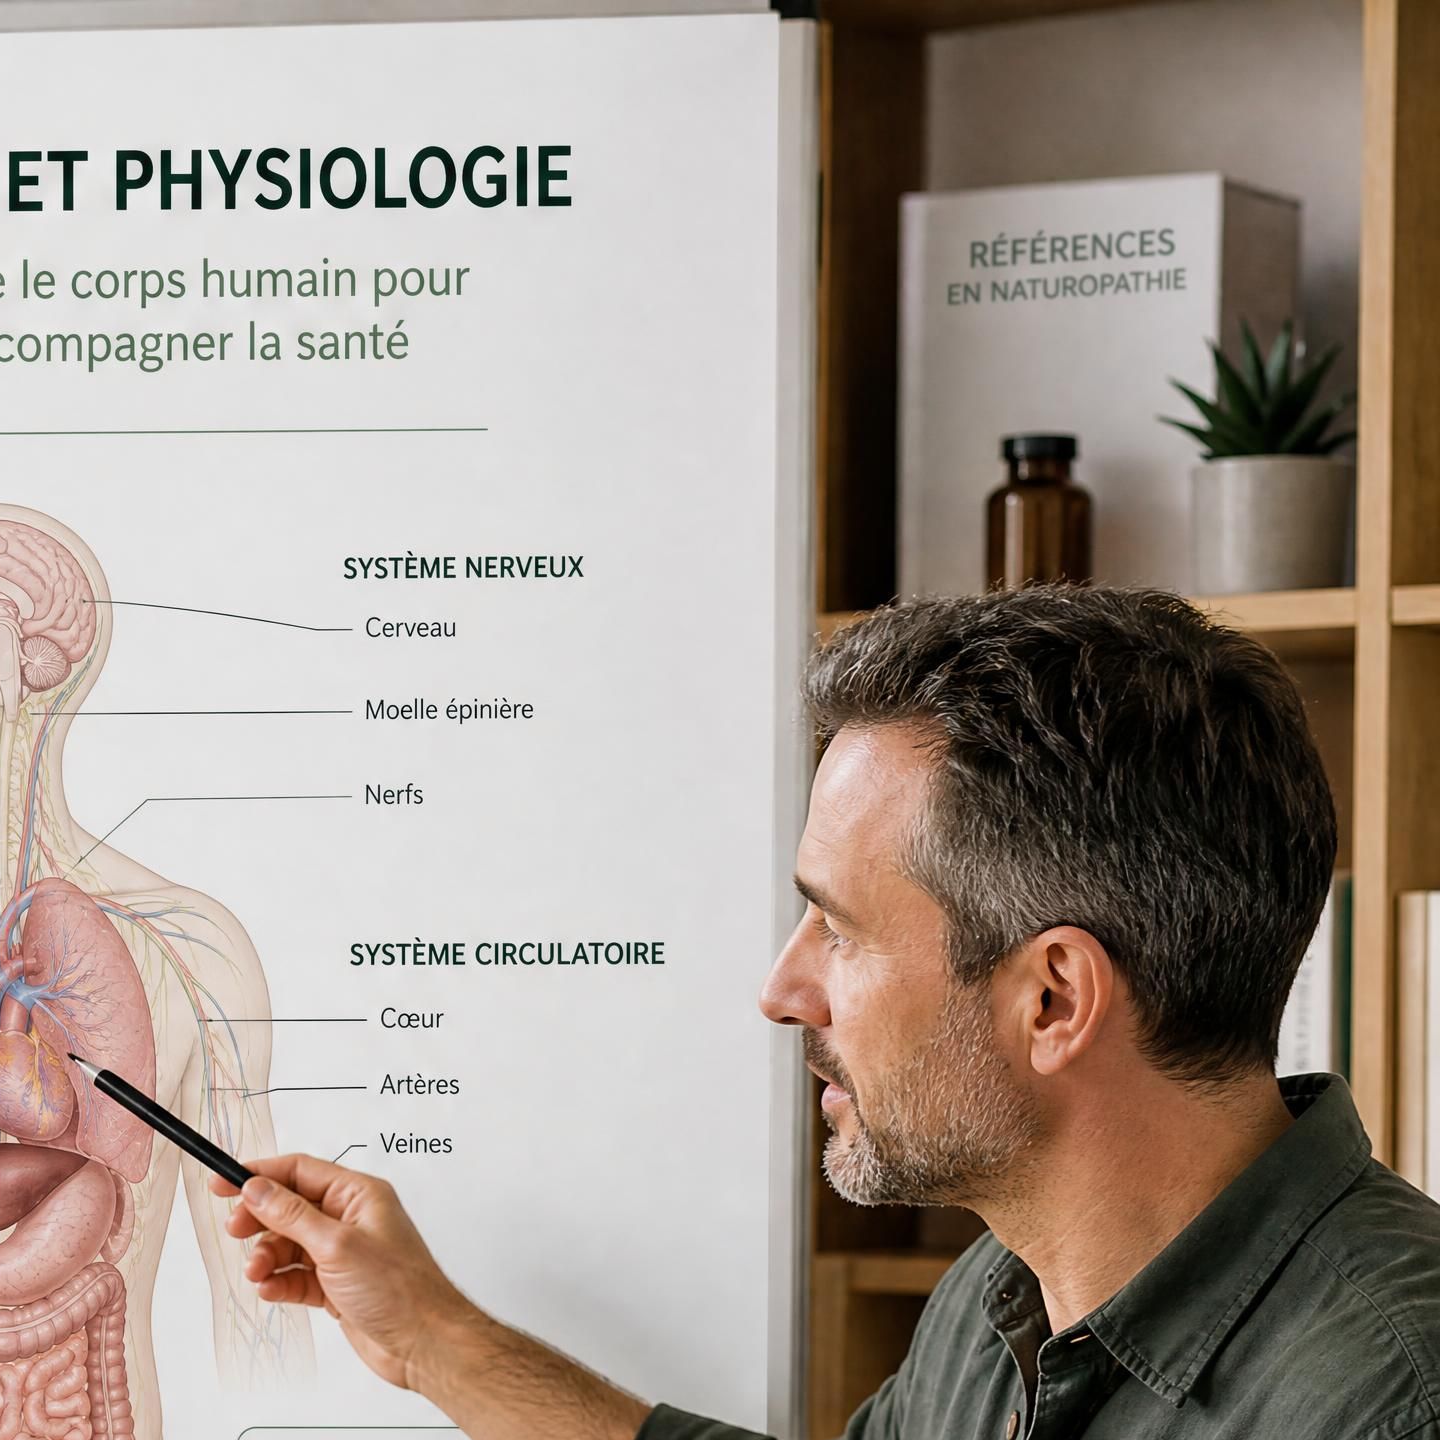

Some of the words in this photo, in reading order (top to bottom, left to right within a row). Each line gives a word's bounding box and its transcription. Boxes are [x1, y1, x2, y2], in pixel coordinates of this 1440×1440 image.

[9, 151, 88, 211] ET
[116, 146, 571, 210] PHYSIOLOGIE
[970, 228, 1175, 268] RÉFÉRENCES
[23, 259, 55, 299] le
[72, 270, 185, 308] corps
[203, 258, 355, 297] humain
[375, 268, 470, 307] pour
[948, 283, 981, 305] EN
[991, 268, 1186, 301] NATUROPATHIE
[250, 321, 281, 360] la
[297, 320, 408, 360] santé
[344, 551, 456, 579] SYSTÈME
[466, 556, 584, 578] NERVEUX
[366, 617, 455, 637] Cerveau
[366, 698, 437, 719] Moelle
[446, 697, 533, 724] épinière
[366, 783, 423, 804] Nerfs
[350, 937, 465, 966] SYSTÈME
[476, 942, 664, 965] CIRCULATOIRE
[381, 1008, 444, 1028] Cœur
[380, 1073, 459, 1094] Artères
[380, 1133, 452, 1153] Veines
